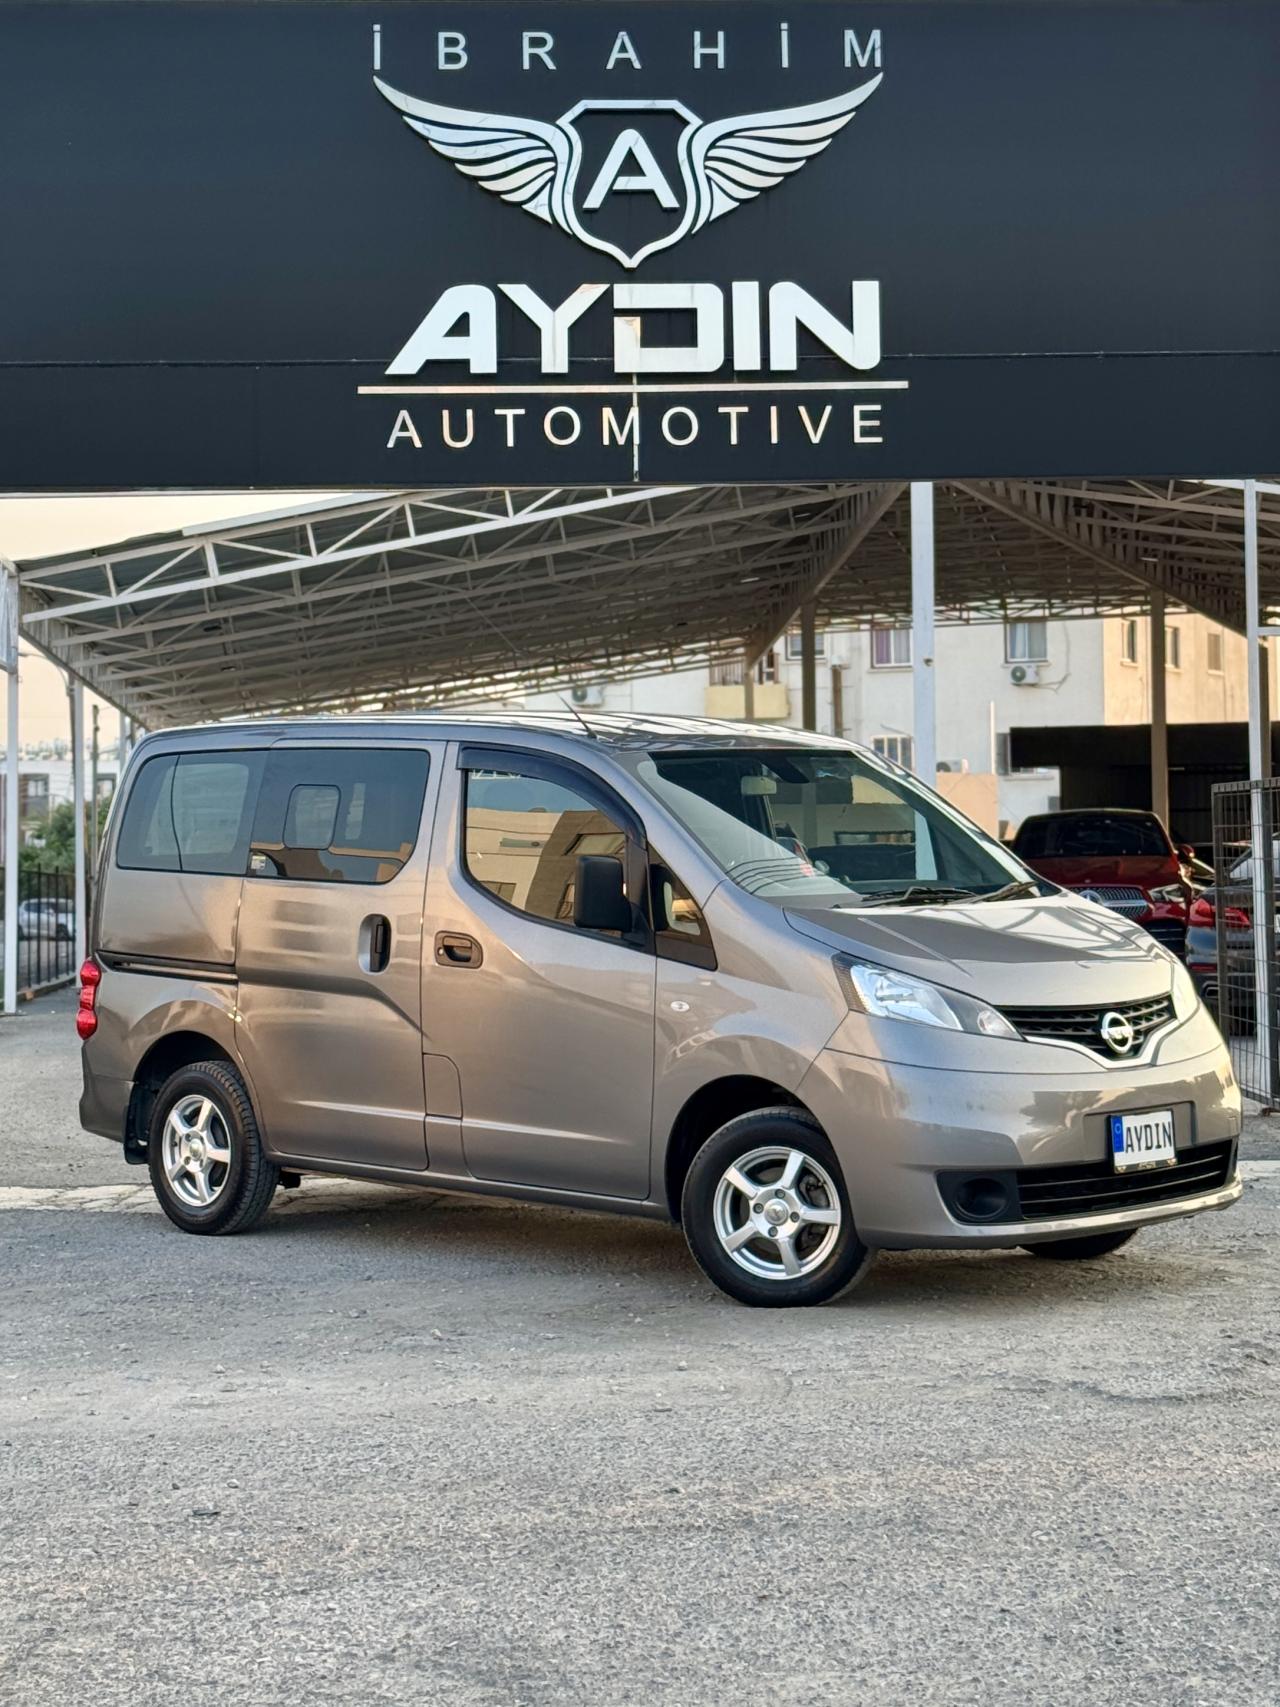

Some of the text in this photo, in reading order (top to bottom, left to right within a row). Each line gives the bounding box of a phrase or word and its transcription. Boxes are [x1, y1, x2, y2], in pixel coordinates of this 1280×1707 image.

[373, 23, 882, 70] İBRAHİM
[583, 128, 680, 210] A
[385, 280, 881, 374] AYDIN
[387, 404, 883, 448] AUTOMOTIVE
[1125, 1121, 1172, 1153] AYDIN
